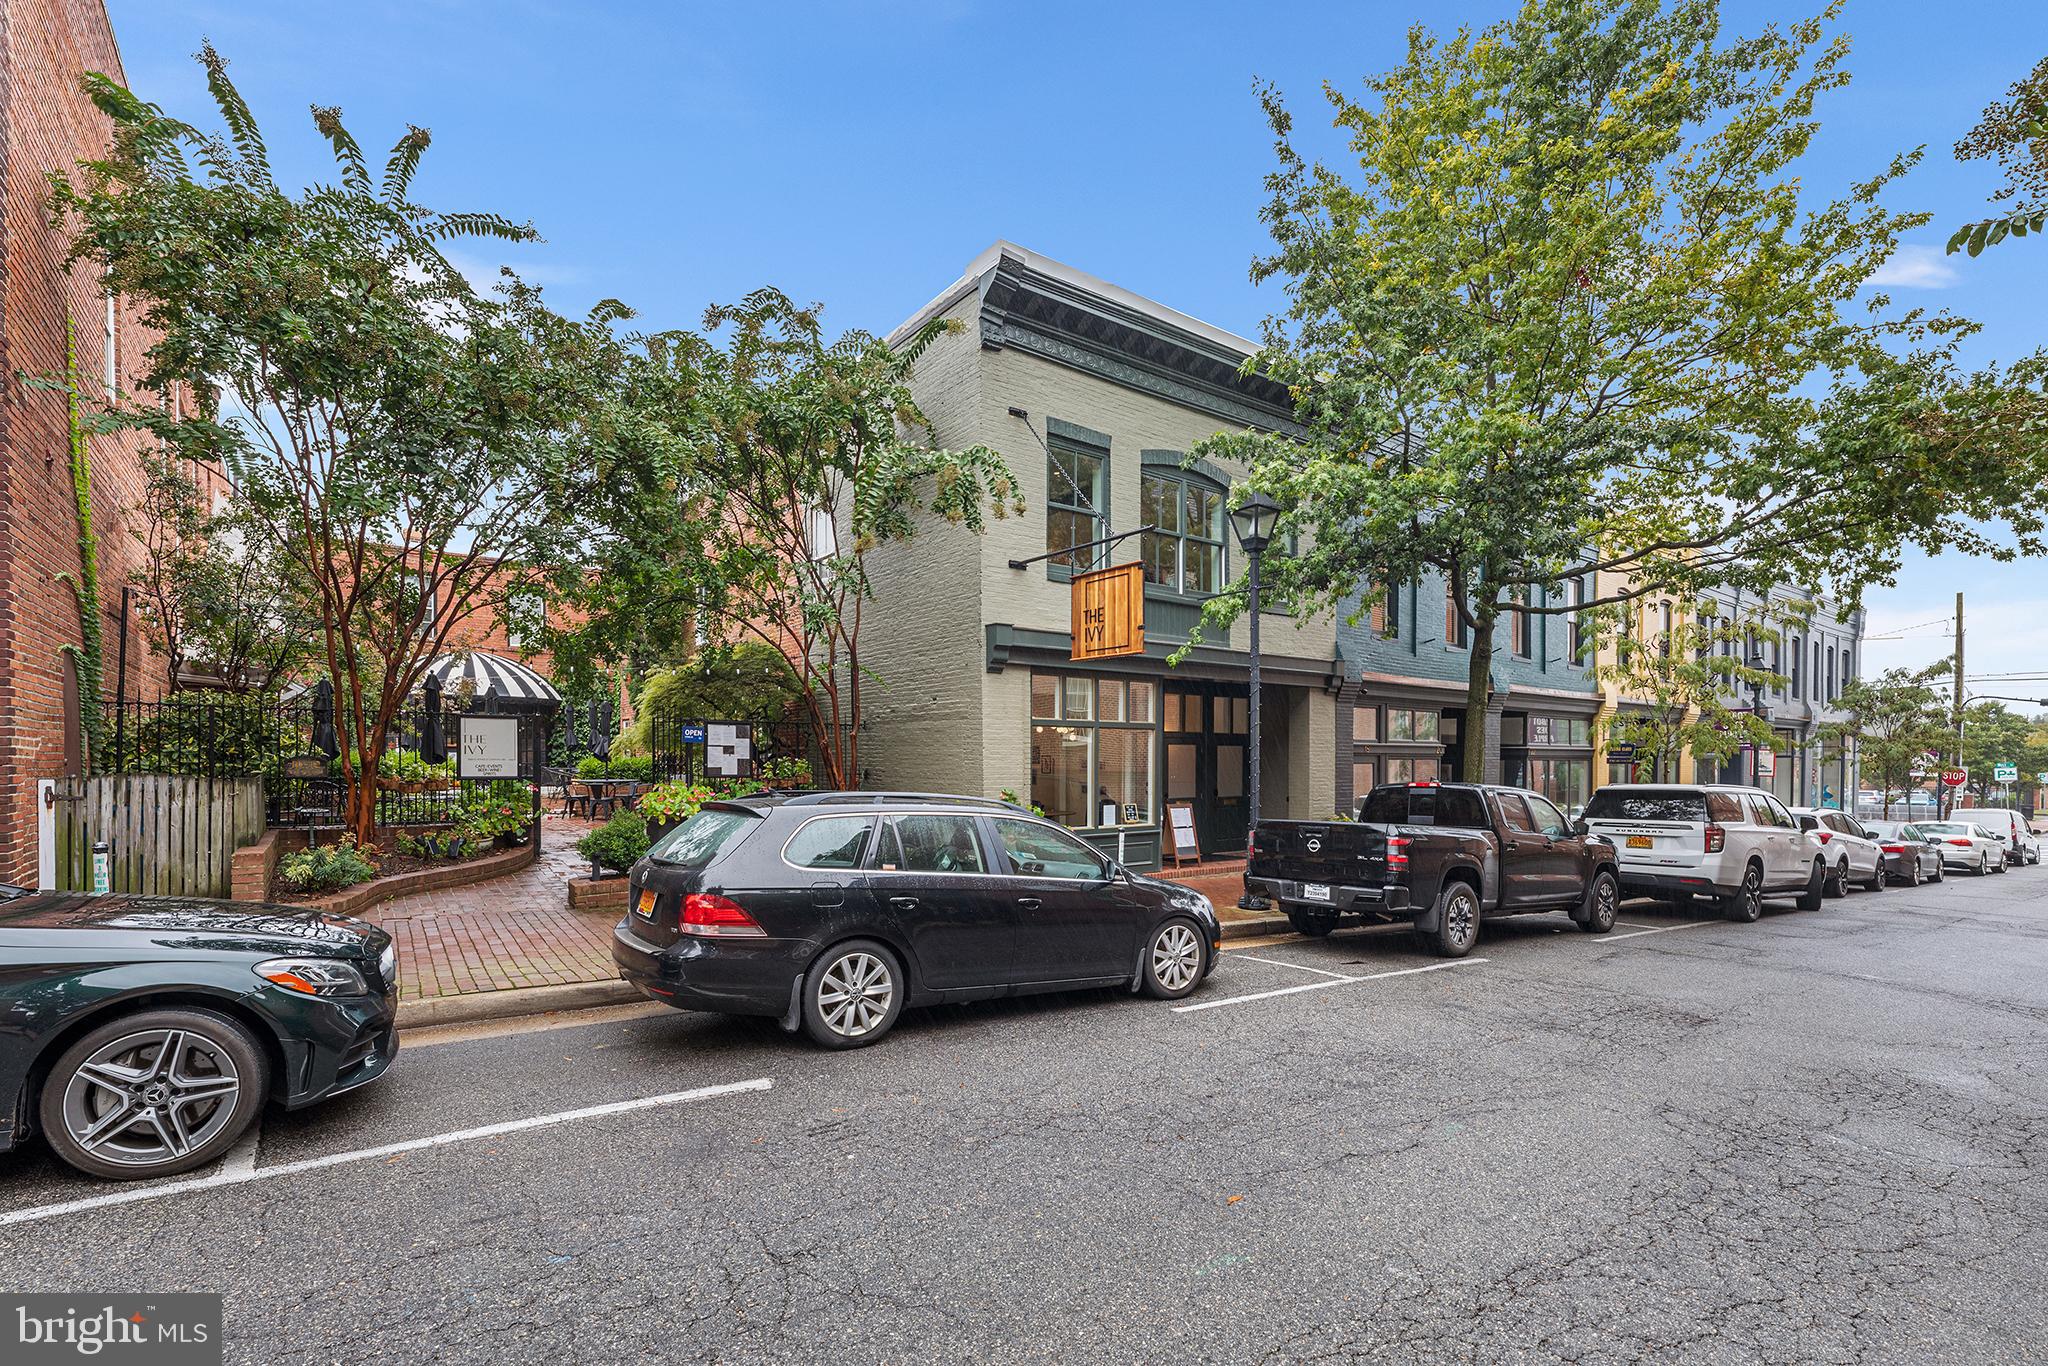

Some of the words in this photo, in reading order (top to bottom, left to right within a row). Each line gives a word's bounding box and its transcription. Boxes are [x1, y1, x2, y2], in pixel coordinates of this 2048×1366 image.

[1083, 607, 1104, 625] THE
[1084, 625, 1104, 643] IVY
[463, 735, 487, 743] THE
[464, 745, 487, 754] IVY
[1943, 770, 1965, 780] STOP
